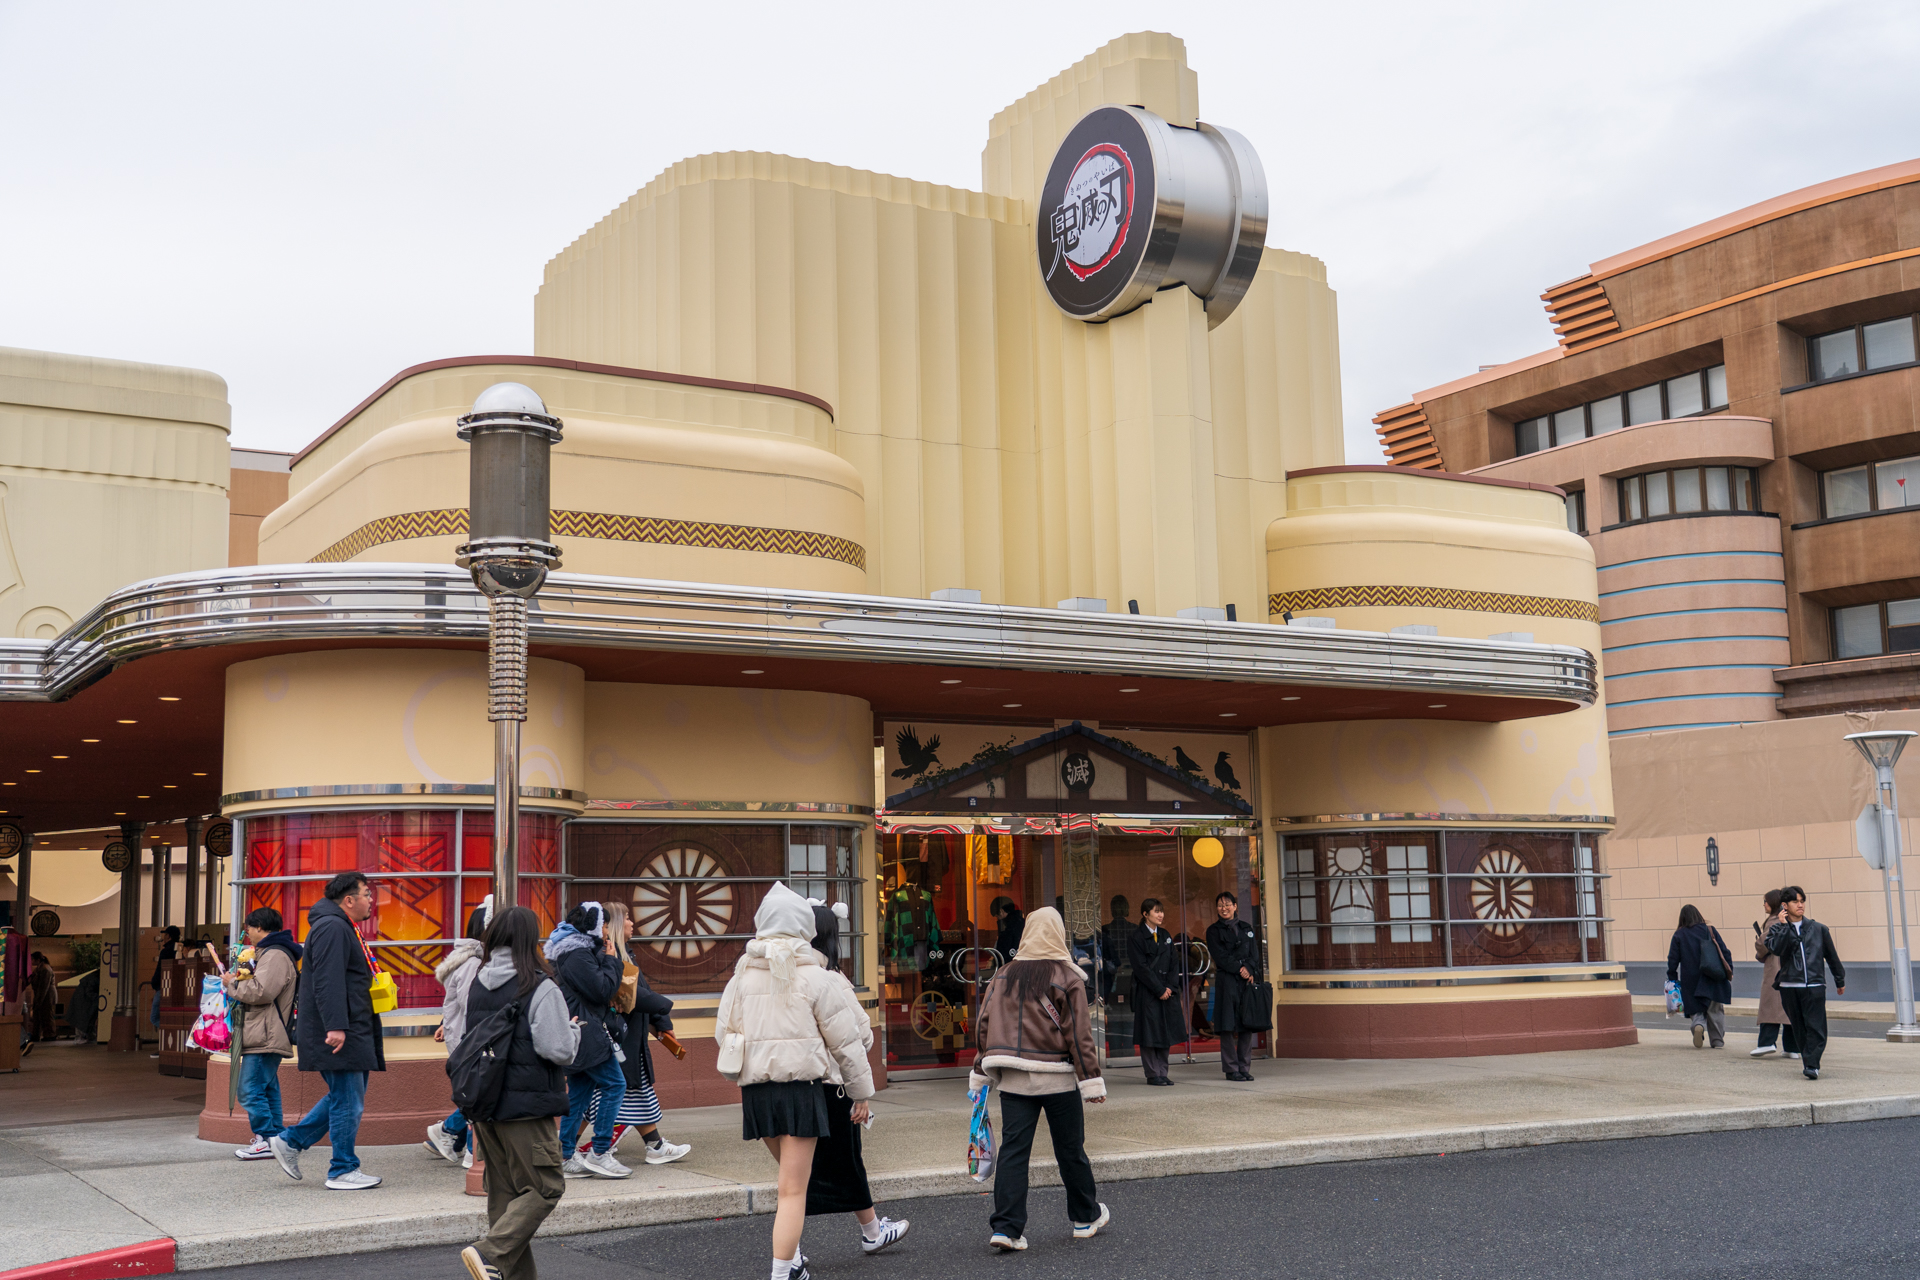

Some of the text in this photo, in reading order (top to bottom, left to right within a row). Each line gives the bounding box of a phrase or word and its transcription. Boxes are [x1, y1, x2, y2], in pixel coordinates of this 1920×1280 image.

[1070, 161, 1115, 196] きめつのやいば
[1046, 165, 1126, 282] 鬼滅の刃
[1066, 758, 1090, 785] 滅
[1046, 1004, 1060, 1022] KANG
